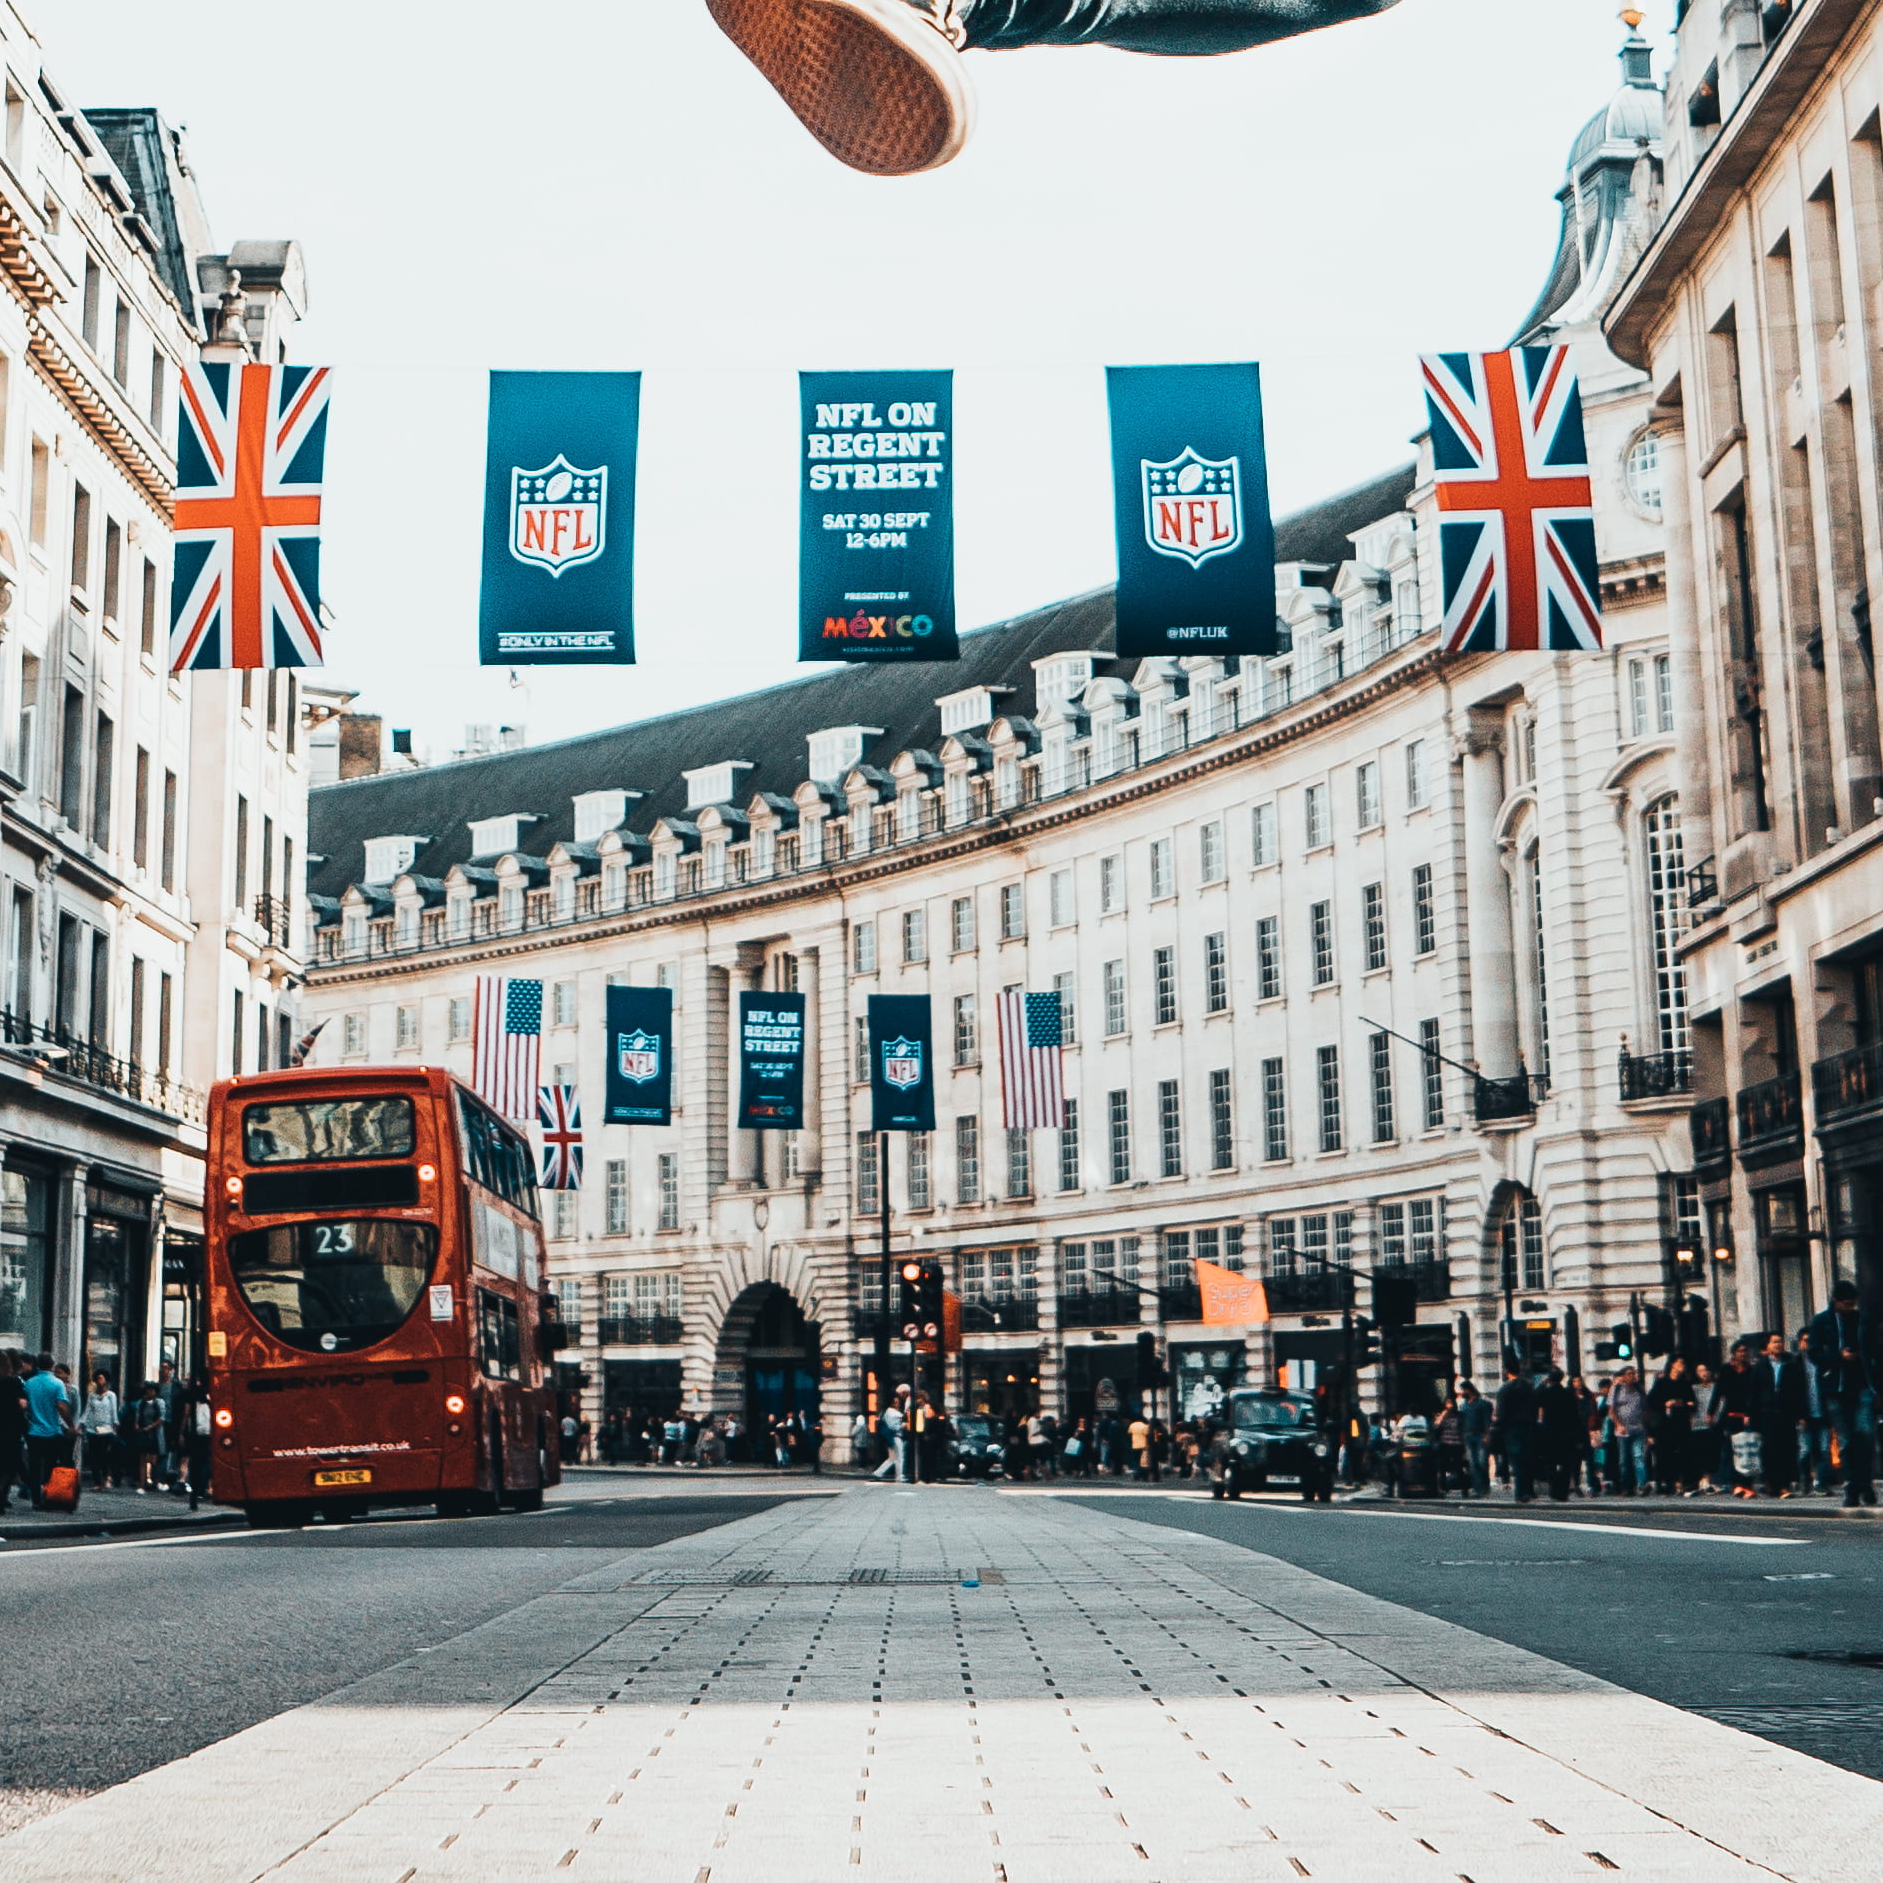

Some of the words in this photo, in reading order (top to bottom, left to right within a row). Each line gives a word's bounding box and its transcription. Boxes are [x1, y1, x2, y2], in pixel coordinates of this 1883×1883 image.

[815, 402, 882, 428] NFL
[887, 402, 937, 427] ON
[807, 432, 945, 459] REGENT
[809, 462, 944, 491] STREET
[822, 514, 857, 530] SAT
[859, 513, 881, 530] 30
[883, 512, 930, 529] SEPT
[1158, 500, 1230, 548] NFL
[523, 509, 592, 557] NFL
[846, 532, 907, 549] 12-6PM
[499, 635, 543, 648] #ONLY
[544, 636, 558, 646] IN
[558, 636, 586, 647] THE
[587, 635, 614, 646] NFL
[1166, 625, 1229, 639] @NFLUK
[743, 1025, 802, 1039] REGENT
[744, 1039, 801, 1054] STREET
[622, 1052, 654, 1075] NFL
[315, 1224, 354, 1254] 23
